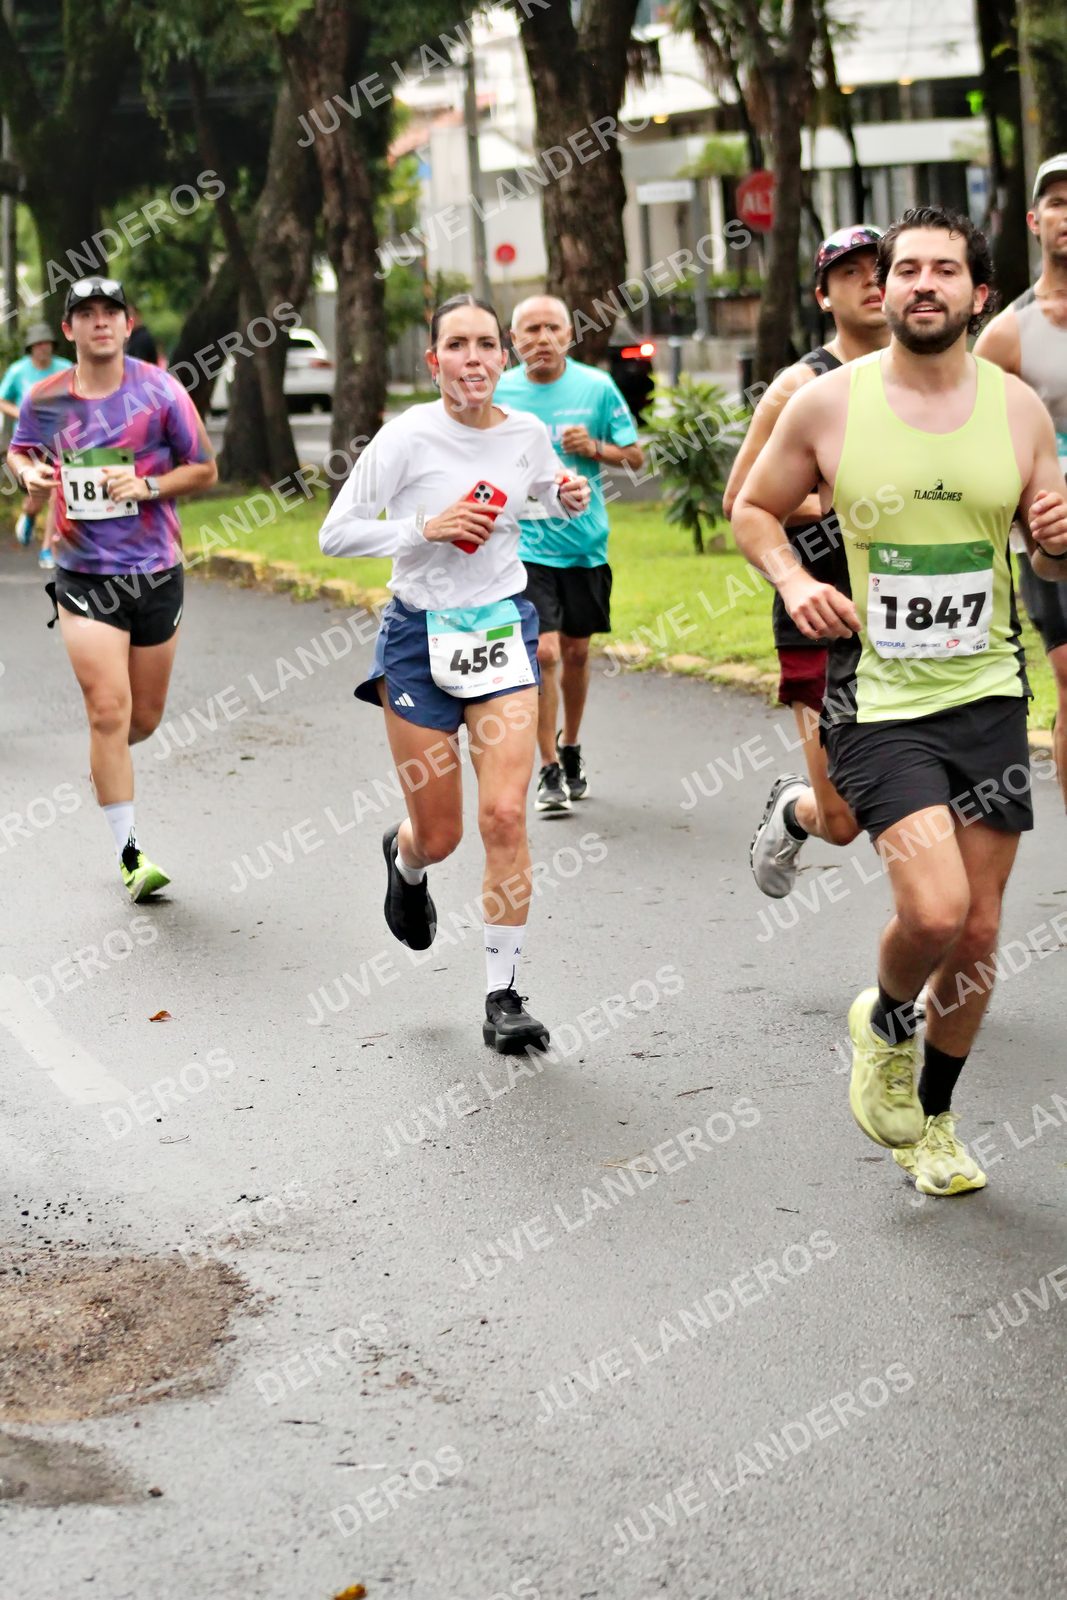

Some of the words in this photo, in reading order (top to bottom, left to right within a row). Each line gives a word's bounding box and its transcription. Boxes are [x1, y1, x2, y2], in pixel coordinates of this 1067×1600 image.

[69, 481, 109, 501] 181
[913, 490, 963, 501] TLACUACHES
[880, 592, 986, 631] 1847
[450, 642, 509, 676] 456
